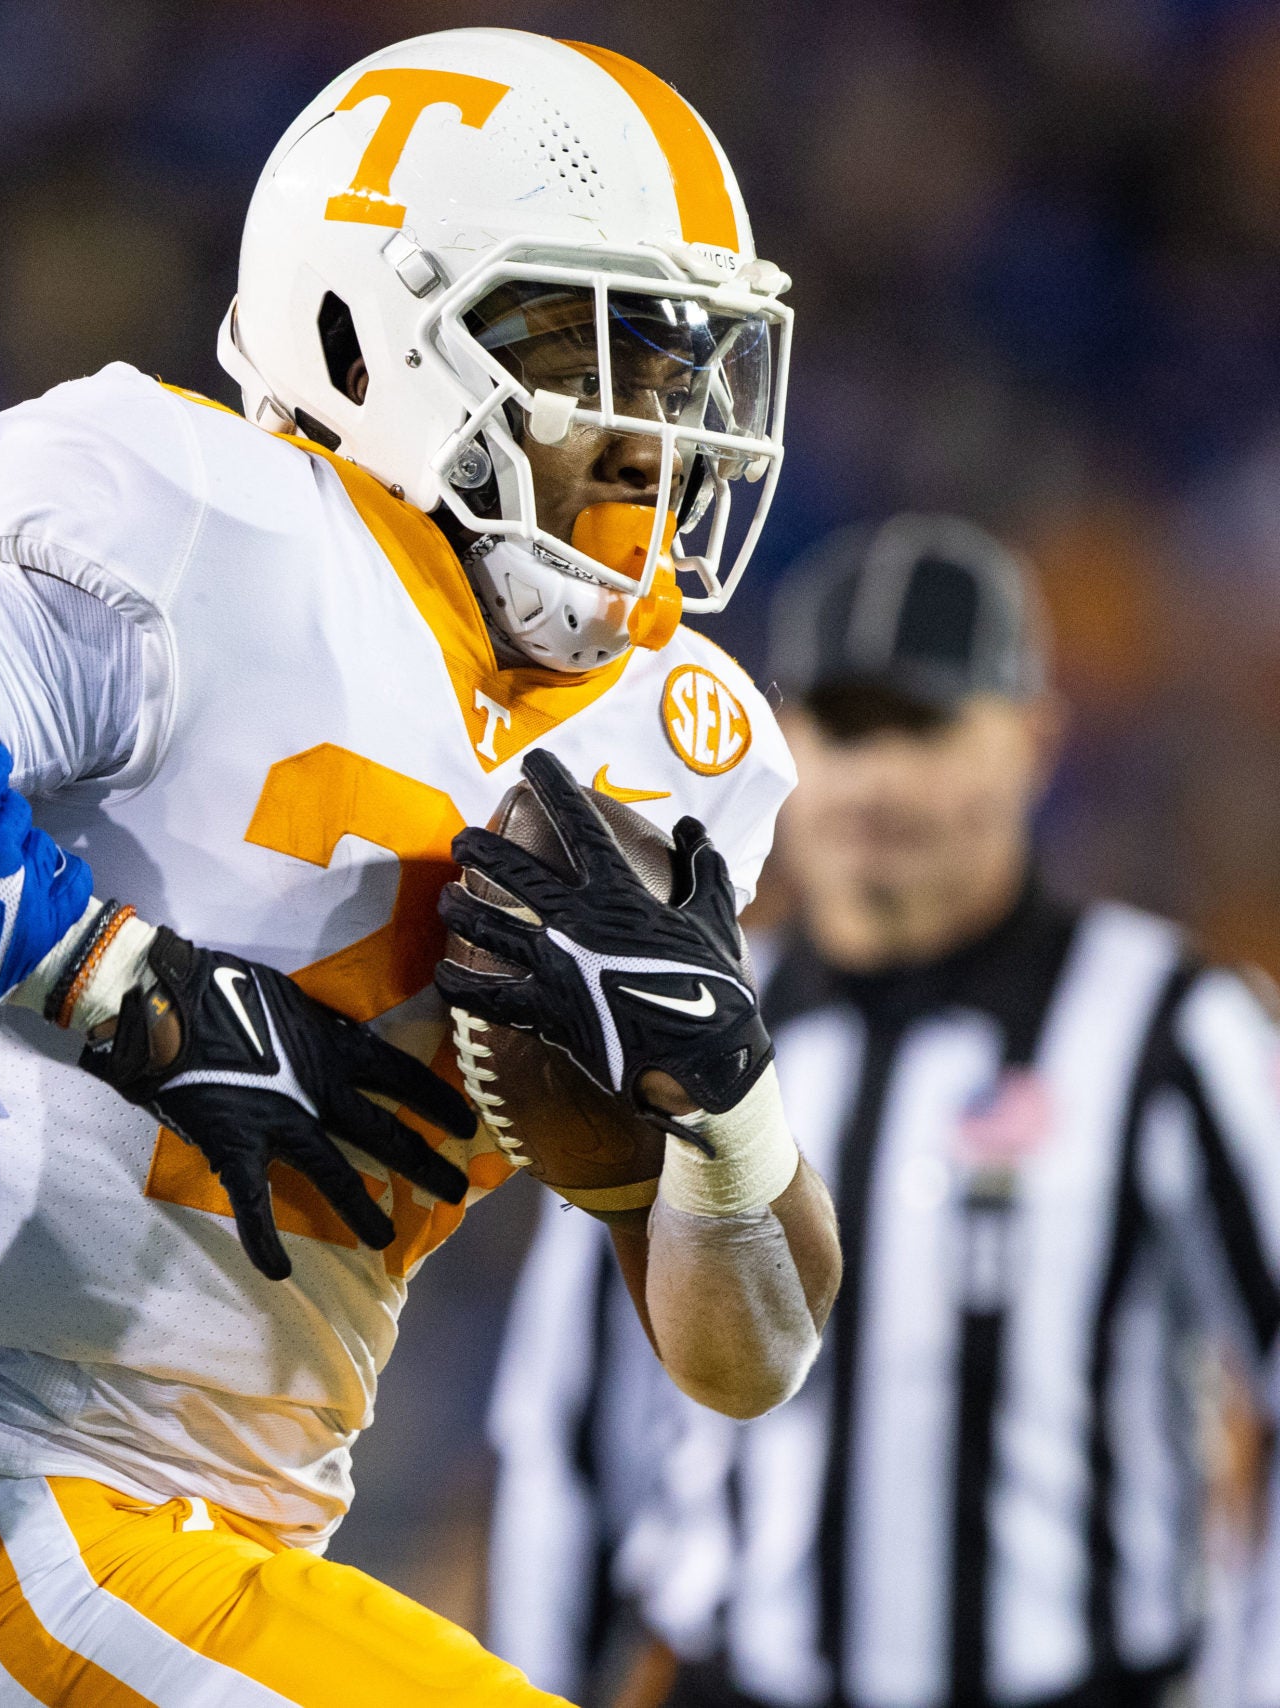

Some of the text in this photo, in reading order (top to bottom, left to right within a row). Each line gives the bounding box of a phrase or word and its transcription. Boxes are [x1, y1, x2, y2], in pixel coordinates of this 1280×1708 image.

[324, 67, 515, 229] T
[473, 686, 512, 763] T
[670, 670, 743, 767] SEC
